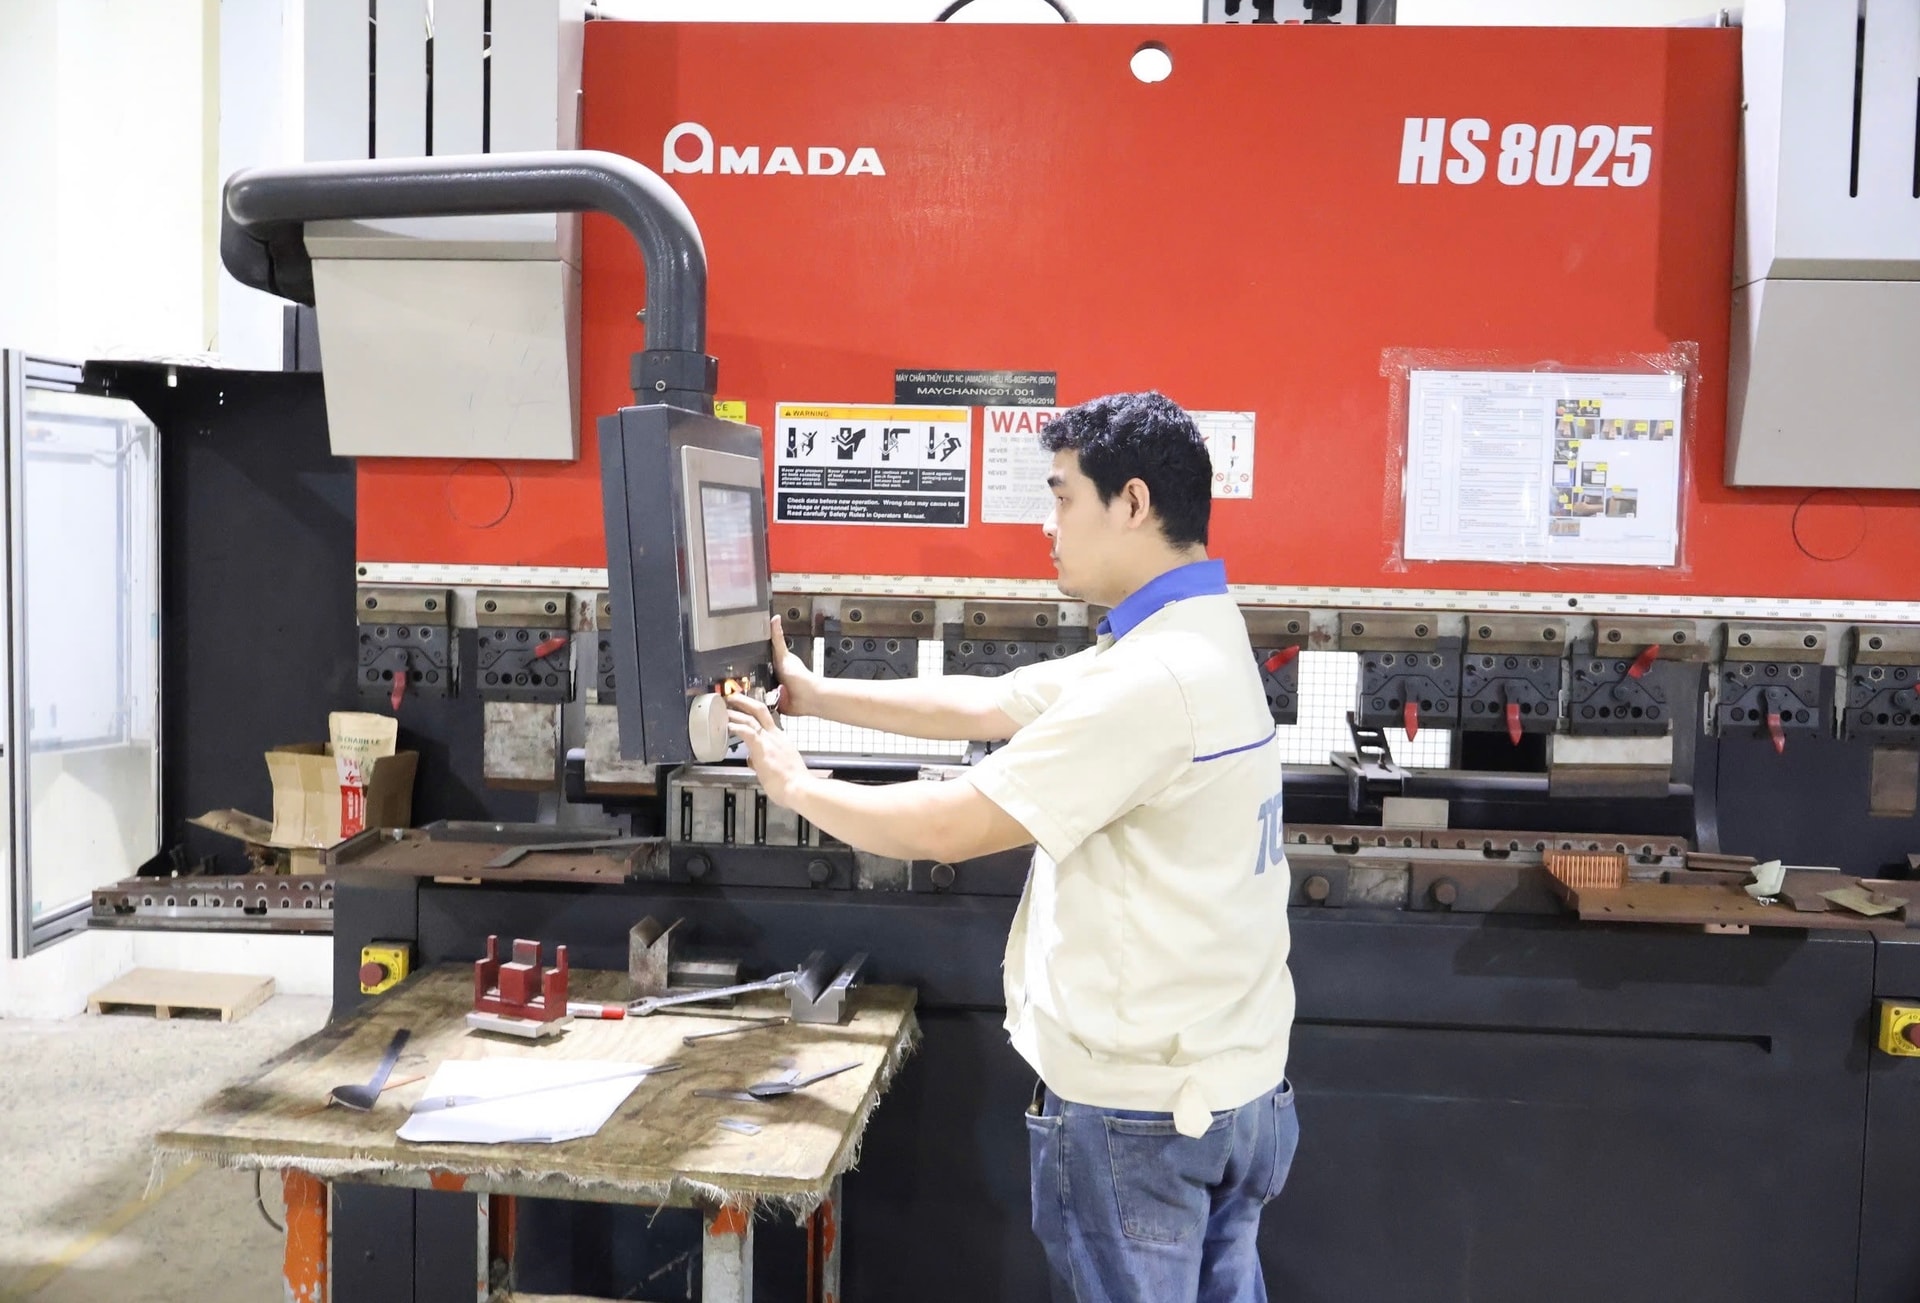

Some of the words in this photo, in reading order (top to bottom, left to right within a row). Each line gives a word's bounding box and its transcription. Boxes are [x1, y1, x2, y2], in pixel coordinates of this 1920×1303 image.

[663, 121, 886, 176] AMADA
[1398, 117, 1491, 184] HS
[1497, 123, 1653, 187] 8025
[917, 387, 1034, 396] MAYCHANNC01.001
[715, 403, 728, 412] CE
[793, 410, 829, 418] WARNING
[991, 411, 1060, 434] WAR
[803, 510, 828, 518] carefully
[829, 511, 848, 519] Safety
[873, 512, 902, 520] Operators
